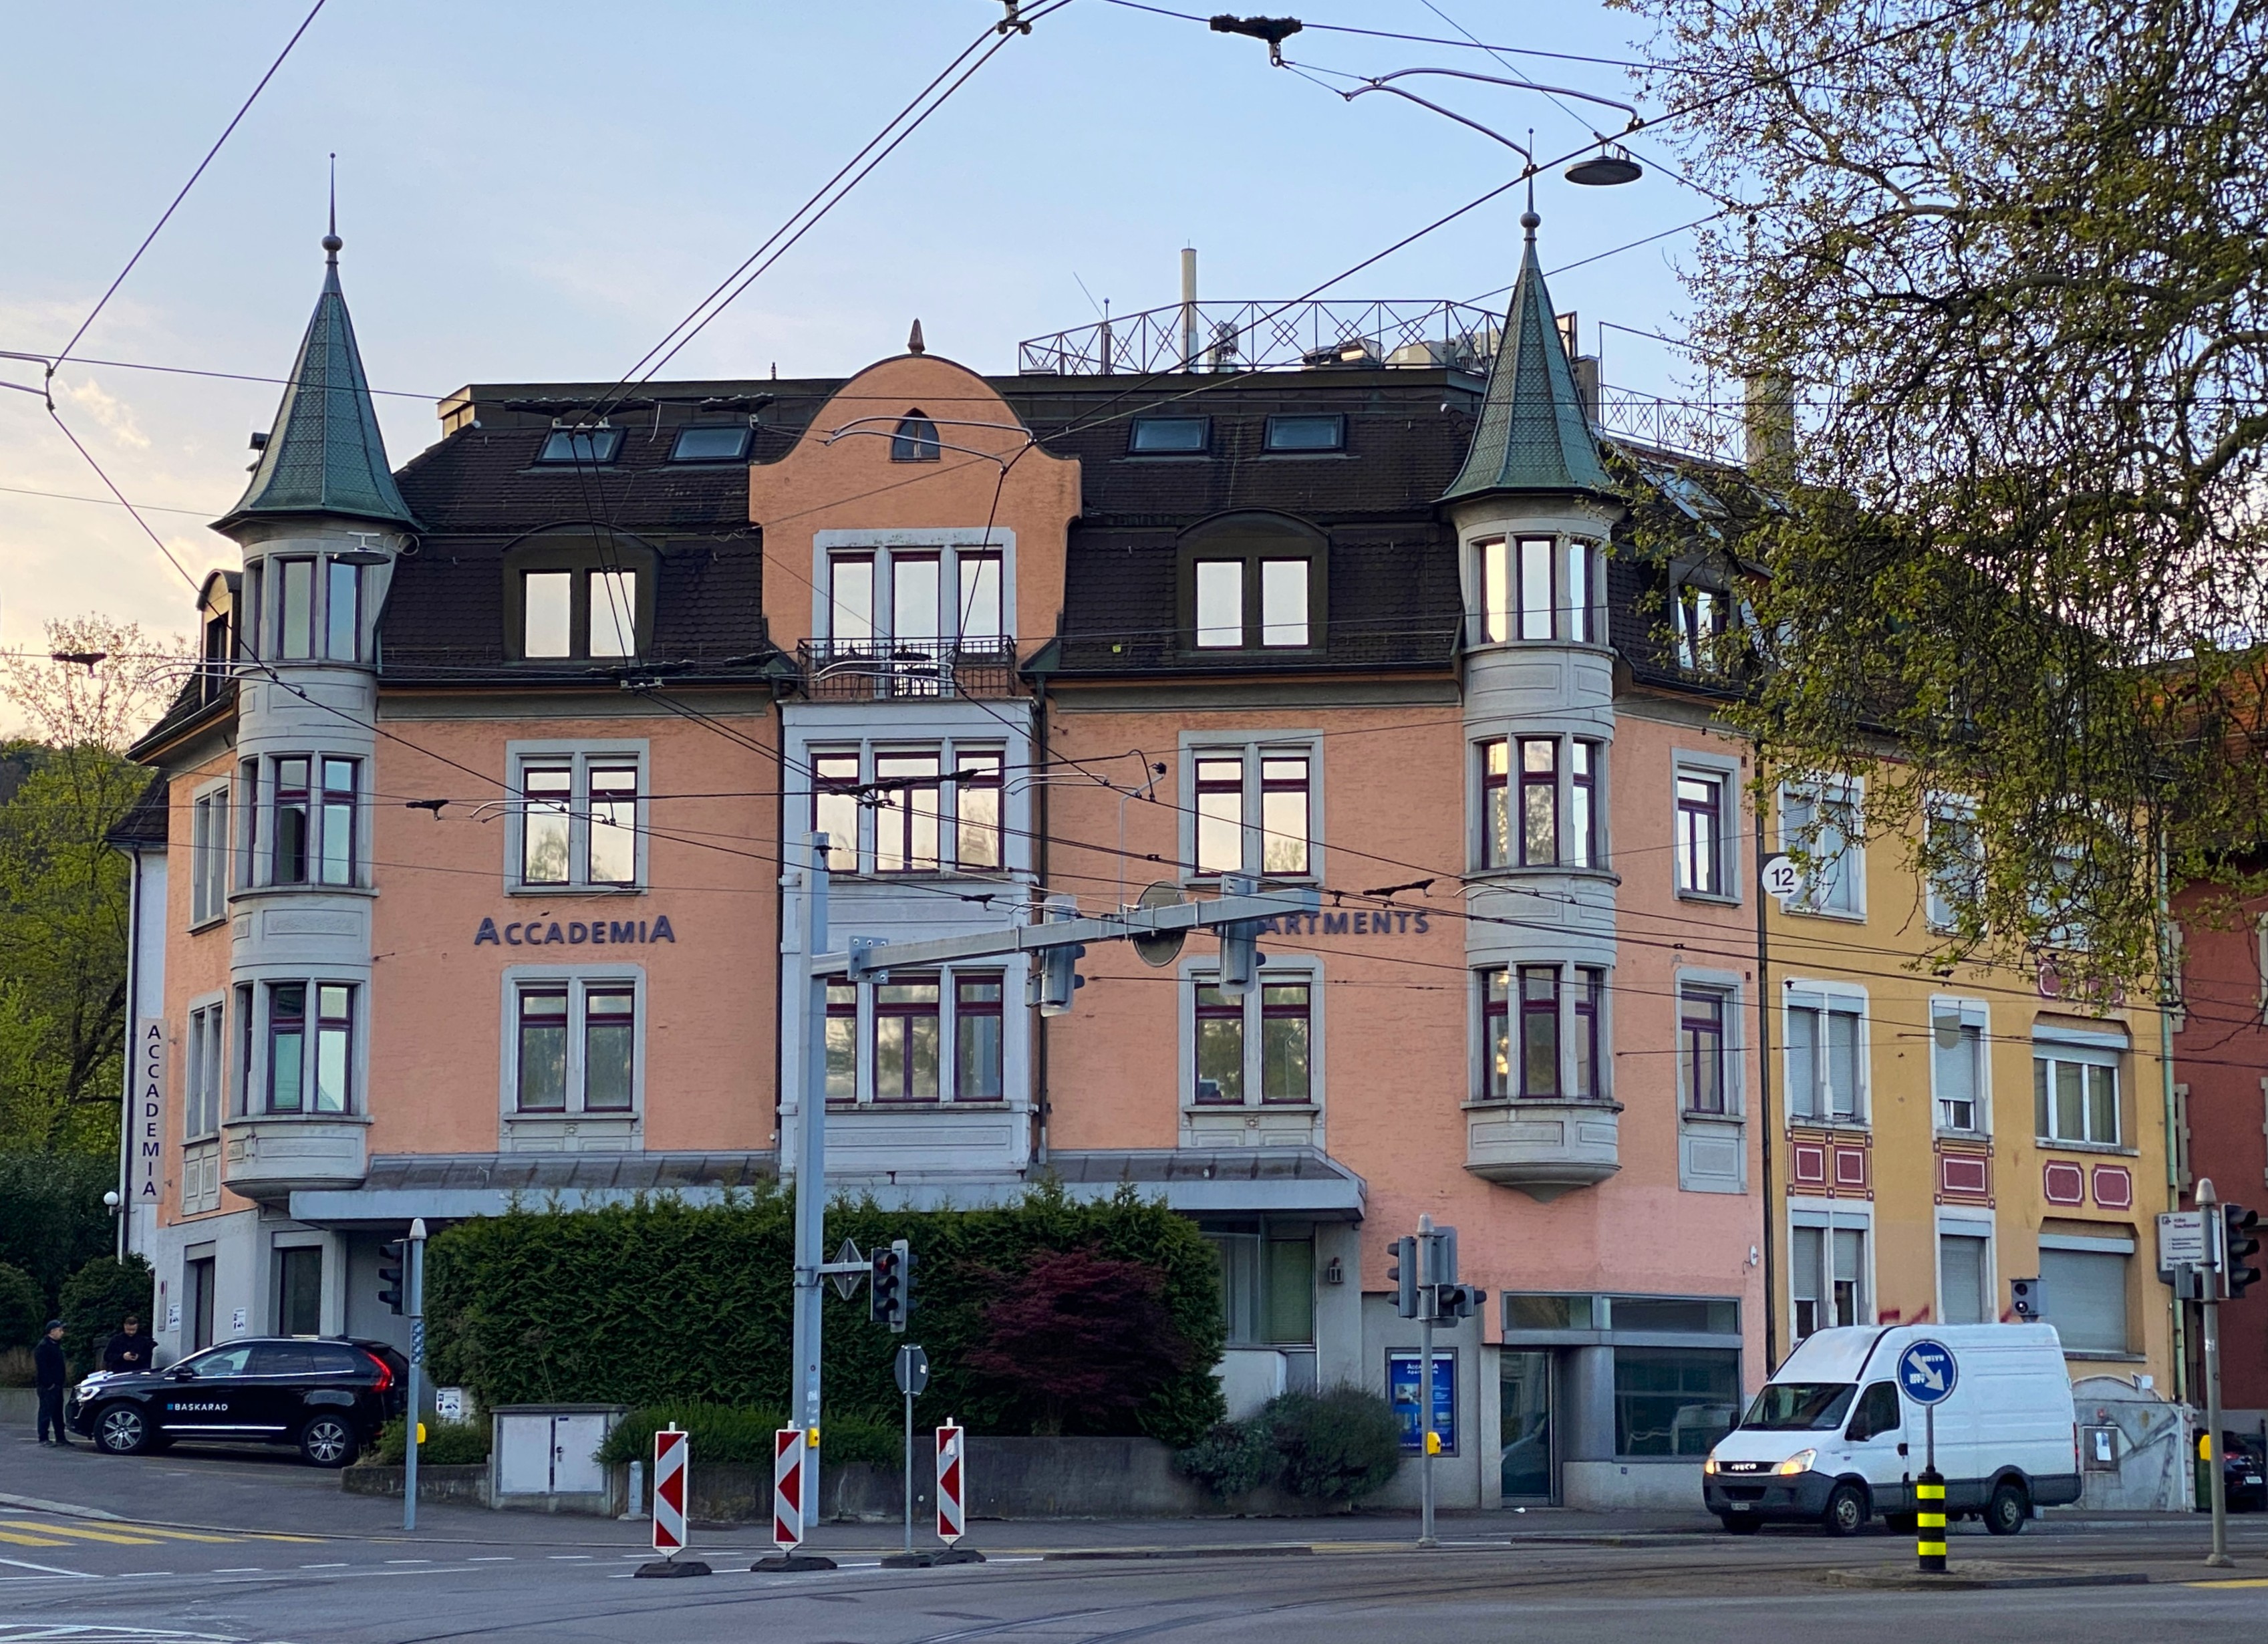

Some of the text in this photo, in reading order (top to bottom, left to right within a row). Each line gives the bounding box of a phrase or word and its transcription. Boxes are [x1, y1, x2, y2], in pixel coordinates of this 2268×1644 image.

[1771, 867, 1794, 886] 12
[474, 916, 675, 945] ACCADEMIA
[1264, 911, 1429, 934] ARTMENTS
[142, 1024, 161, 1196] ACCADEMIA
